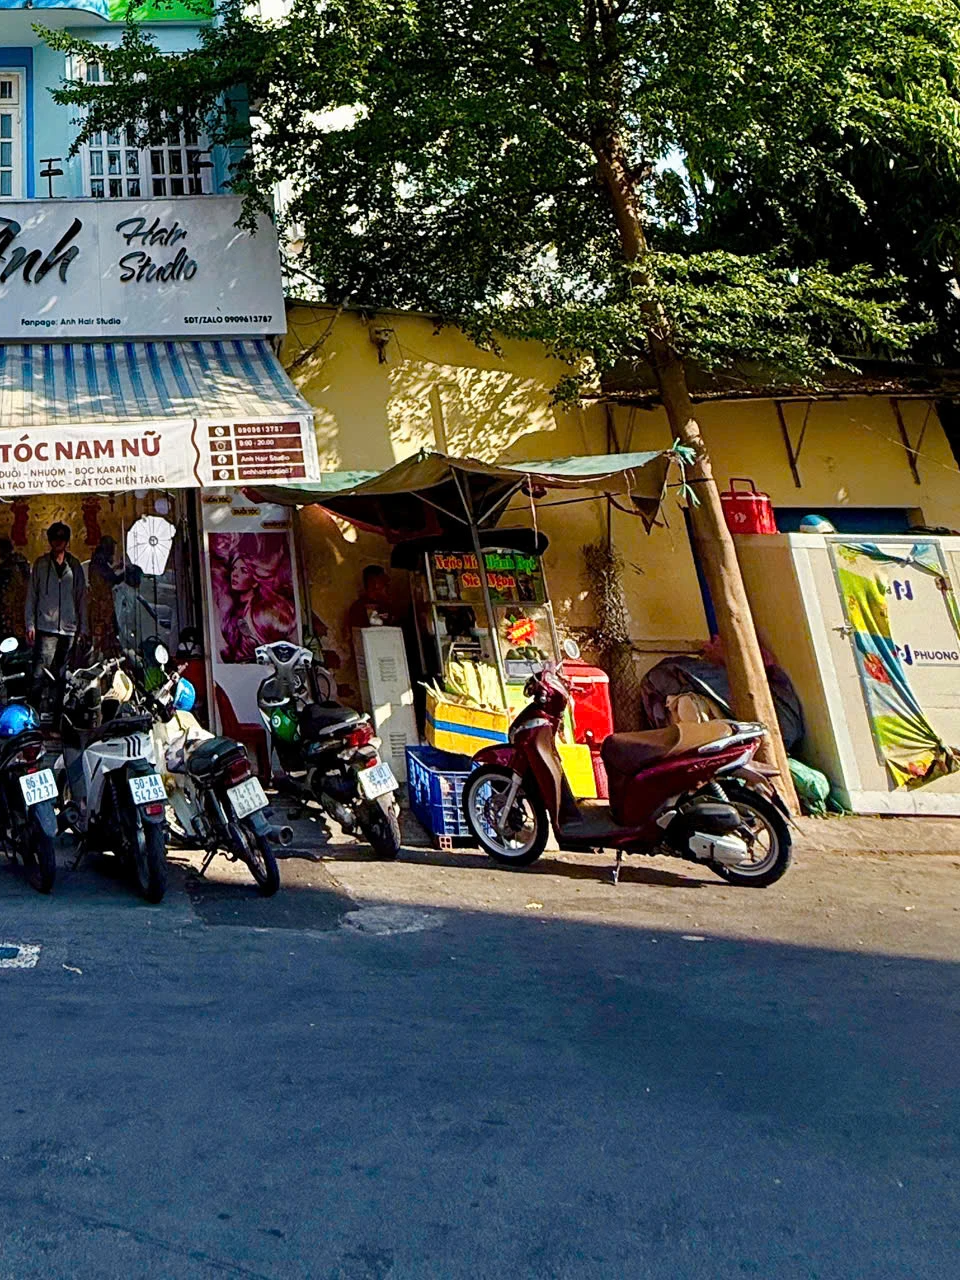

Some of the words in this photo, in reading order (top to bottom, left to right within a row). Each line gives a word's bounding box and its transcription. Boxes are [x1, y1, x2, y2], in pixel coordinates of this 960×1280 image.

[116, 217, 188, 246] Hair
[119, 247, 198, 282] Studio
[60, 318, 76, 326] Anh
[78, 317, 94, 325] Hair
[96, 317, 121, 325] Studio
[0, 434, 49, 463] TÓC
[55, 439, 115, 461] NAM
[121, 430, 162, 457] NỮ
[96, 465, 136, 475] KARATIN
[512, 624, 531, 638] HOT
[913, 650, 959, 661] PHUONG
